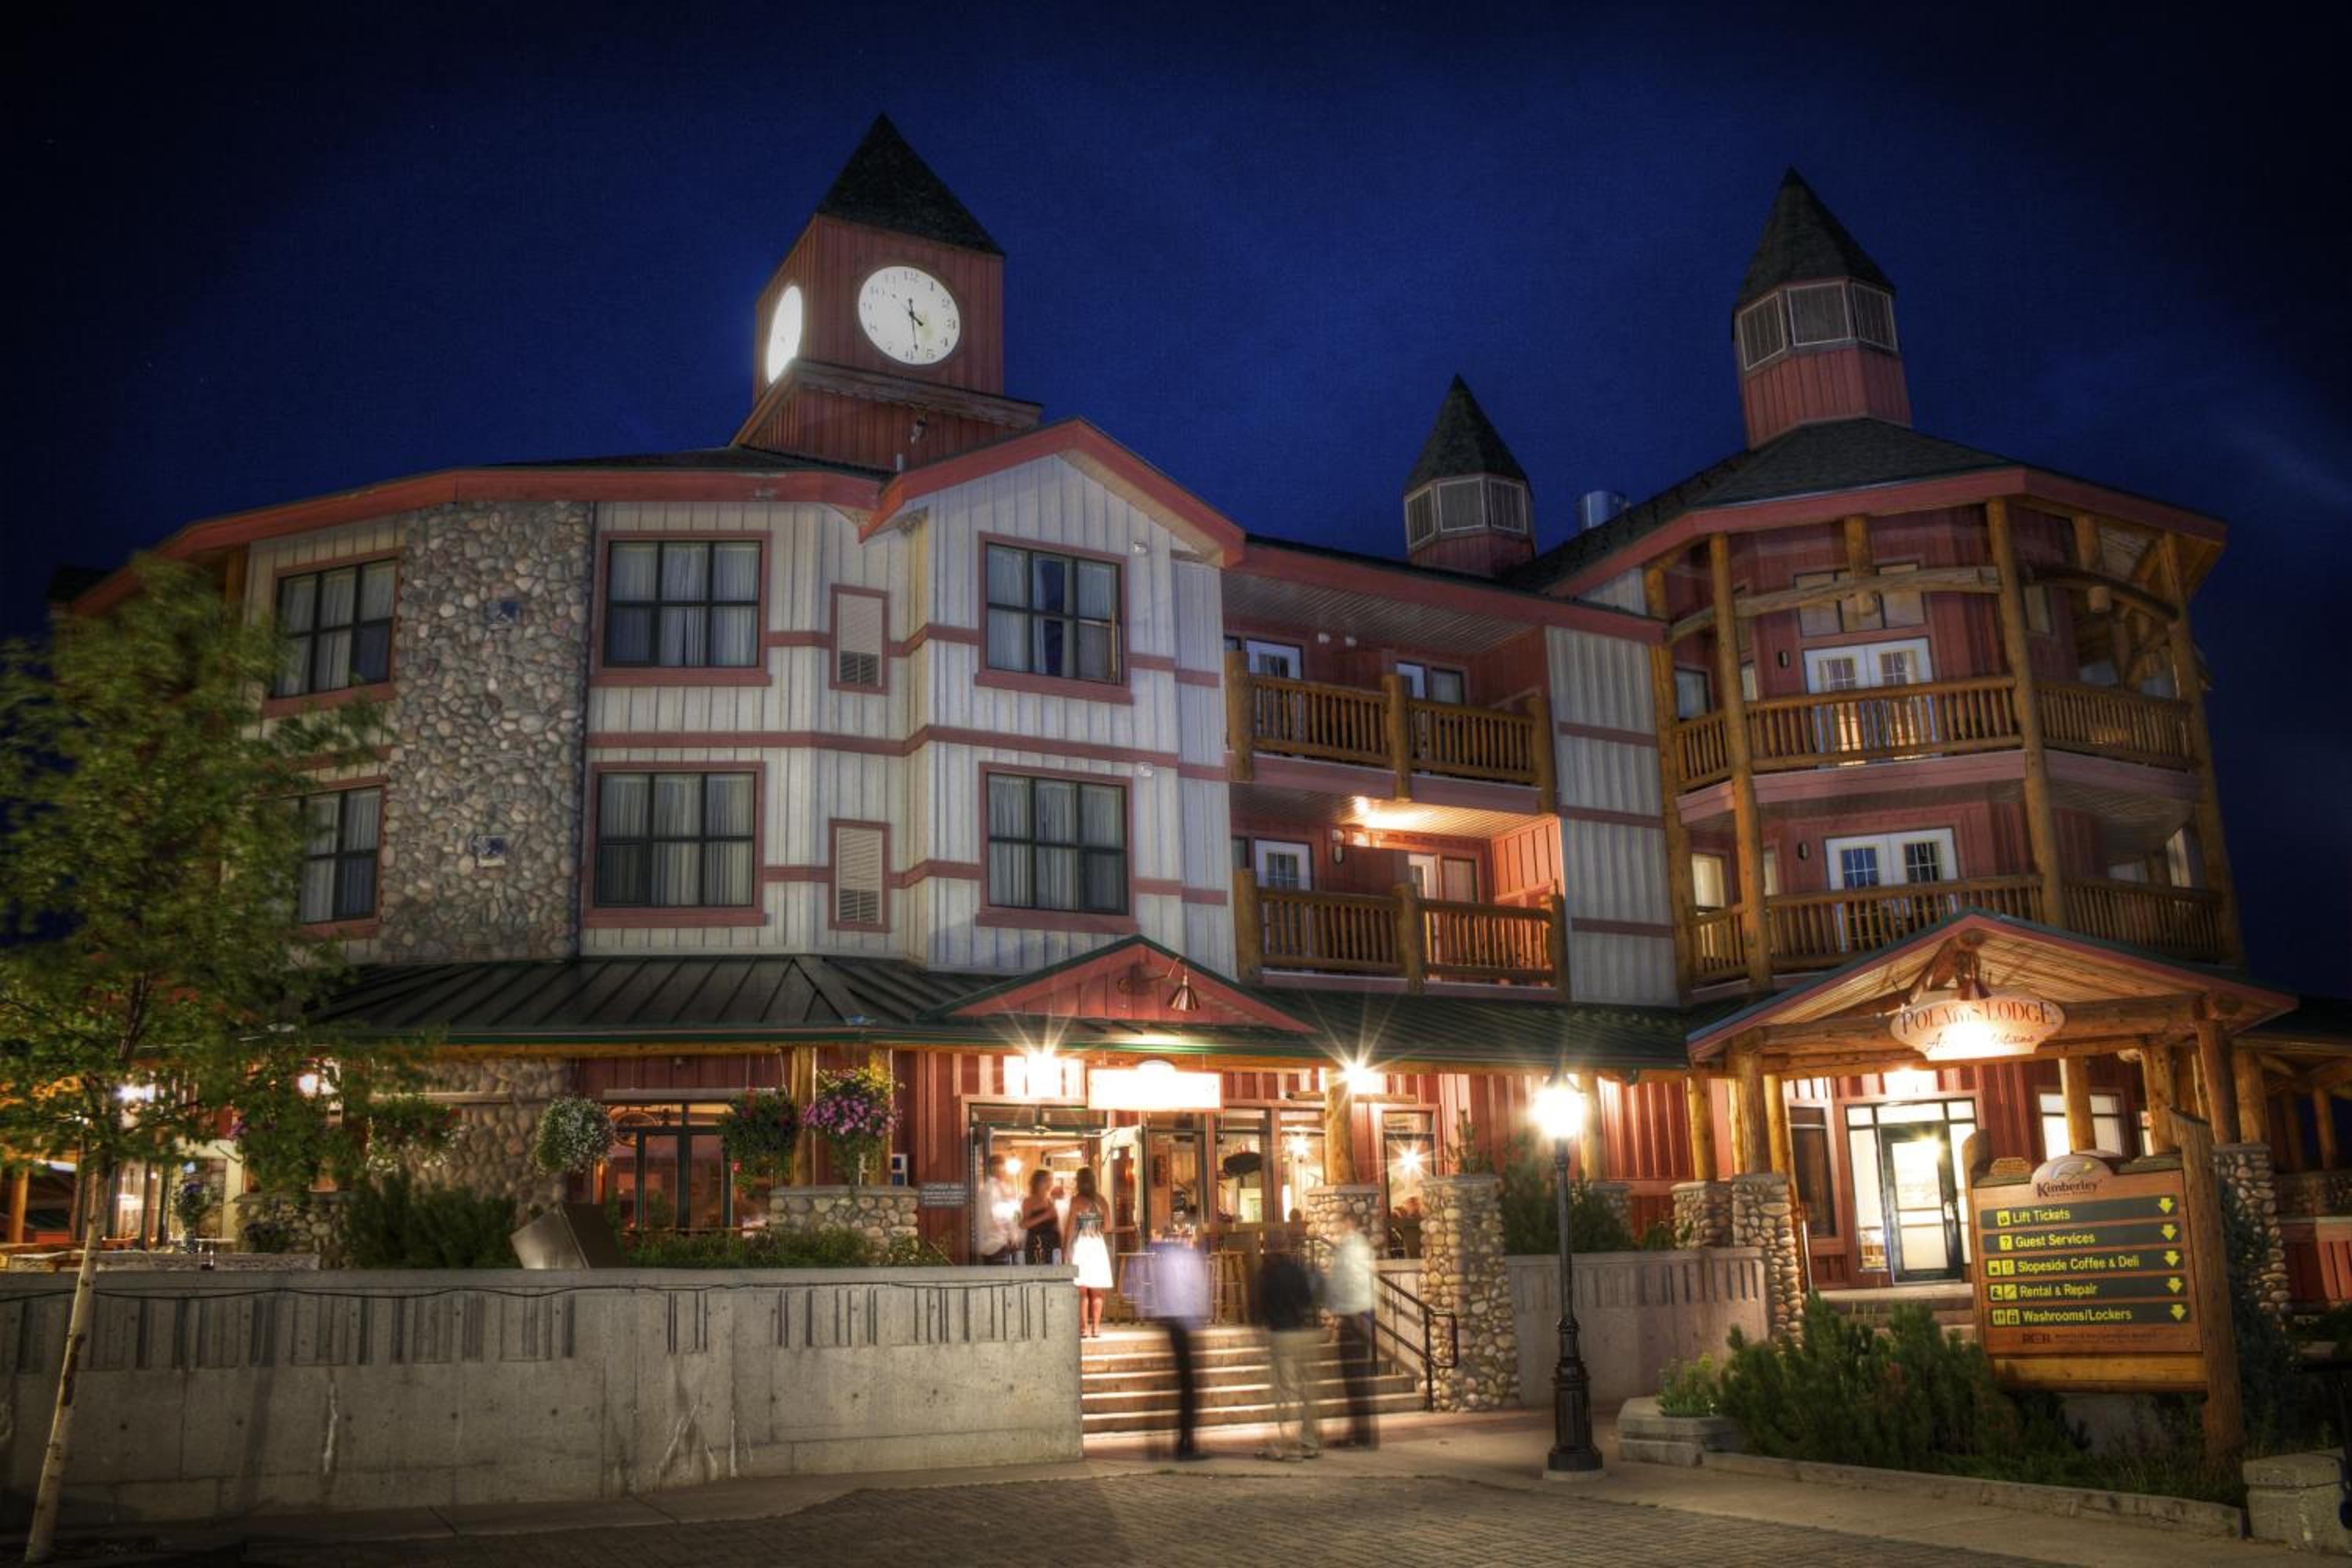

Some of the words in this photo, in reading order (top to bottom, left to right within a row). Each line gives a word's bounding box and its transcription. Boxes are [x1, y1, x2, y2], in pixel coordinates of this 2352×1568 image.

[1985, 1000, 2058, 1024] LODGE
[2035, 1178, 2097, 1198] Kimberley
[2013, 1210, 2031, 1223] Lift
[2033, 1208, 2071, 1221] Tickets
[2015, 1236, 2045, 1248] Guest
[2048, 1232, 2096, 1247] Services
[2017, 1260, 2067, 1274] Slopeside
[2070, 1257, 2106, 1269] Coffee
[2108, 1257, 2116, 1268] &
[2118, 1255, 2140, 1268] Deli
[2019, 1285, 2053, 1298] Rental
[2063, 1283, 2098, 1299] Repair
[2022, 1308, 2133, 1323] Washrooms/Lockers
